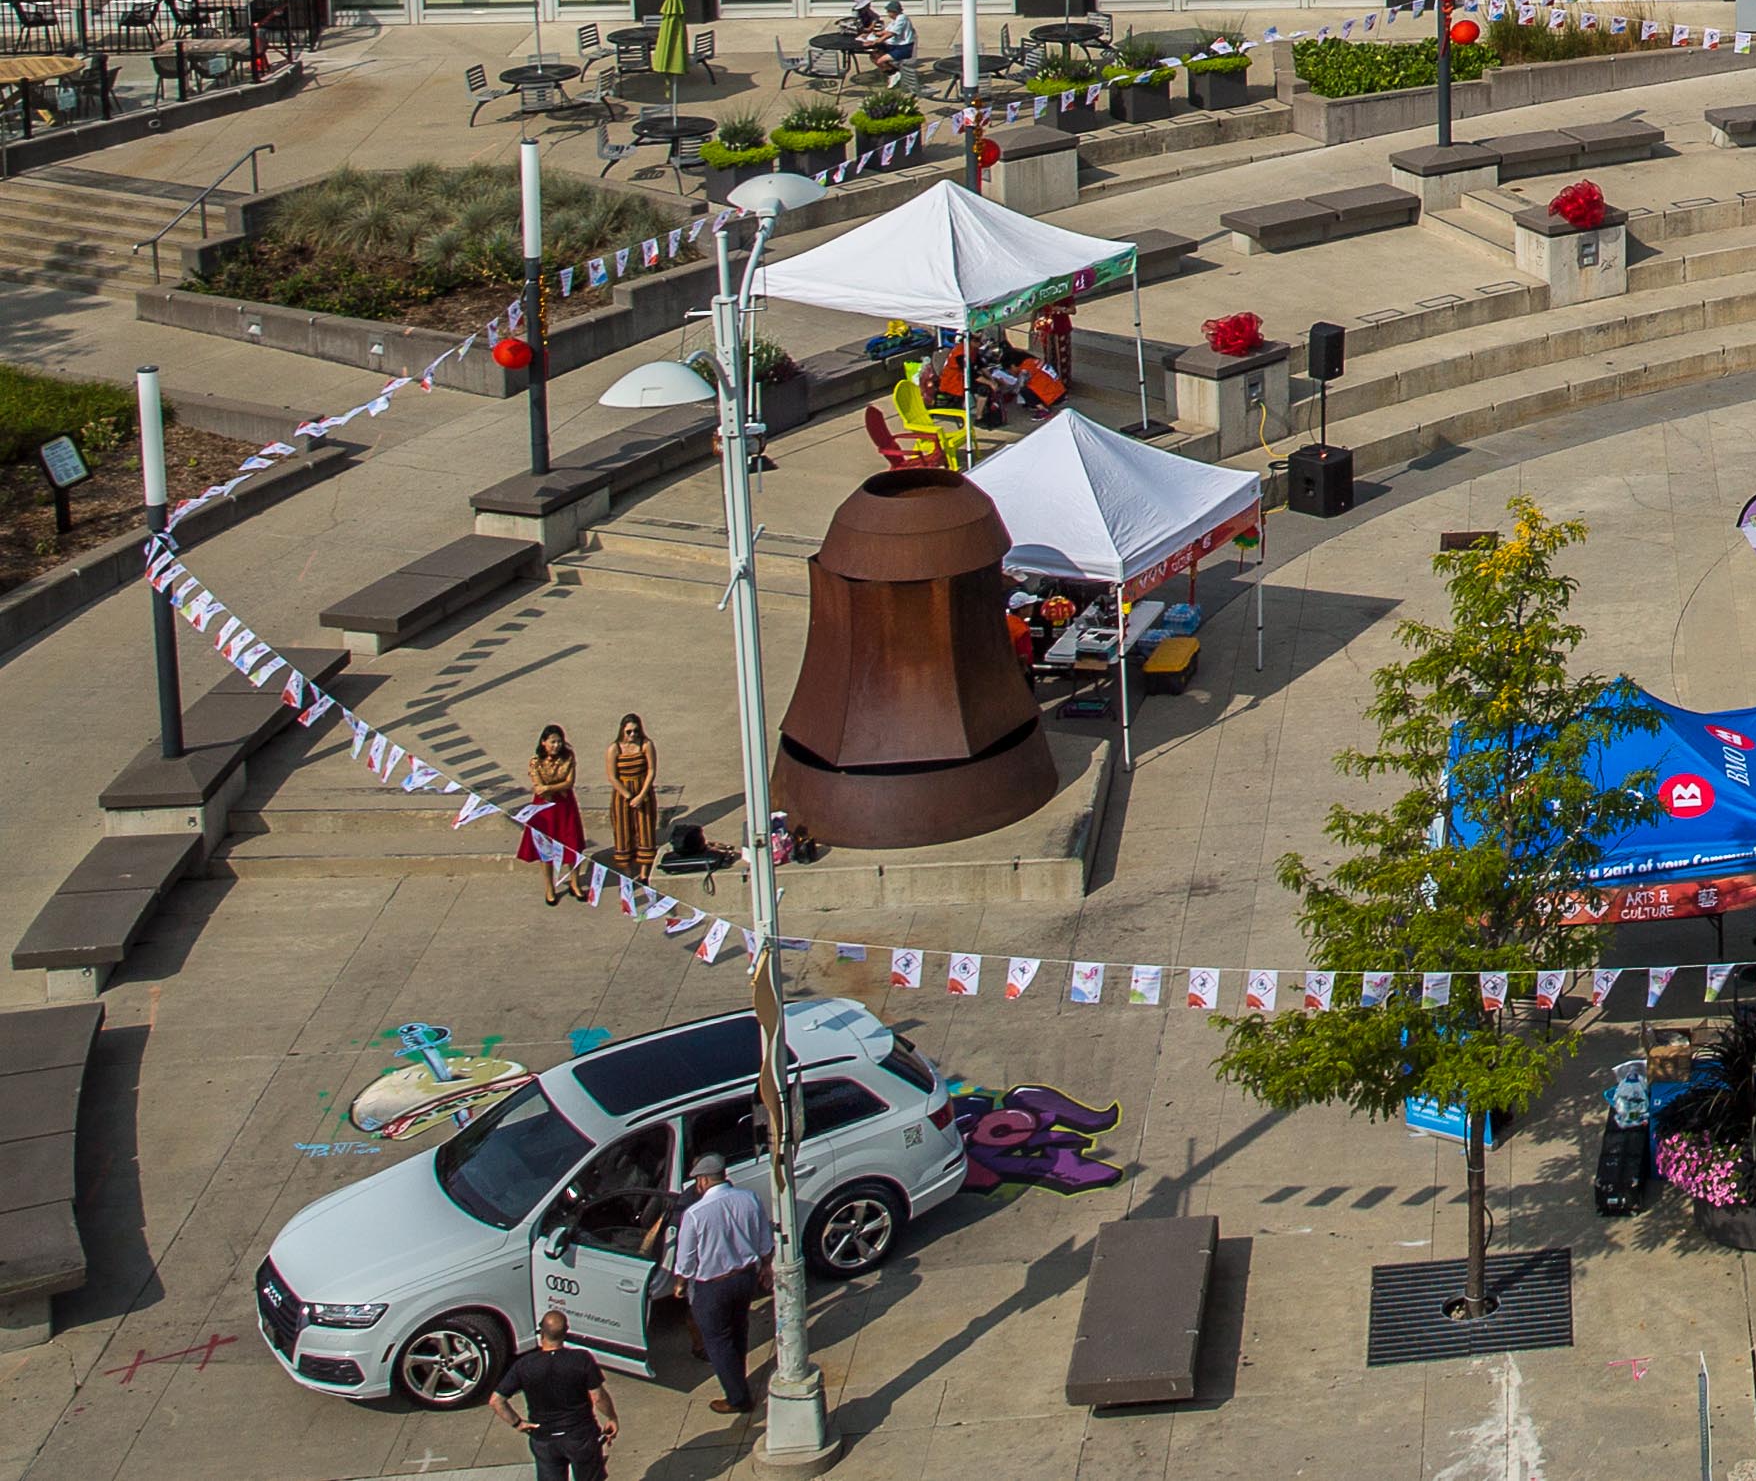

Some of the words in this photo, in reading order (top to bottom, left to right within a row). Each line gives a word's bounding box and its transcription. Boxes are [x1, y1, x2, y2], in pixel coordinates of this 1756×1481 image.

[1723, 745, 1750, 787] BMO
[1590, 868, 1600, 879] a
[1603, 861, 1635, 880] part
[1637, 859, 1654, 874] of
[1625, 889, 1656, 906] ARTS
[1620, 904, 1675, 920] CULTURE
